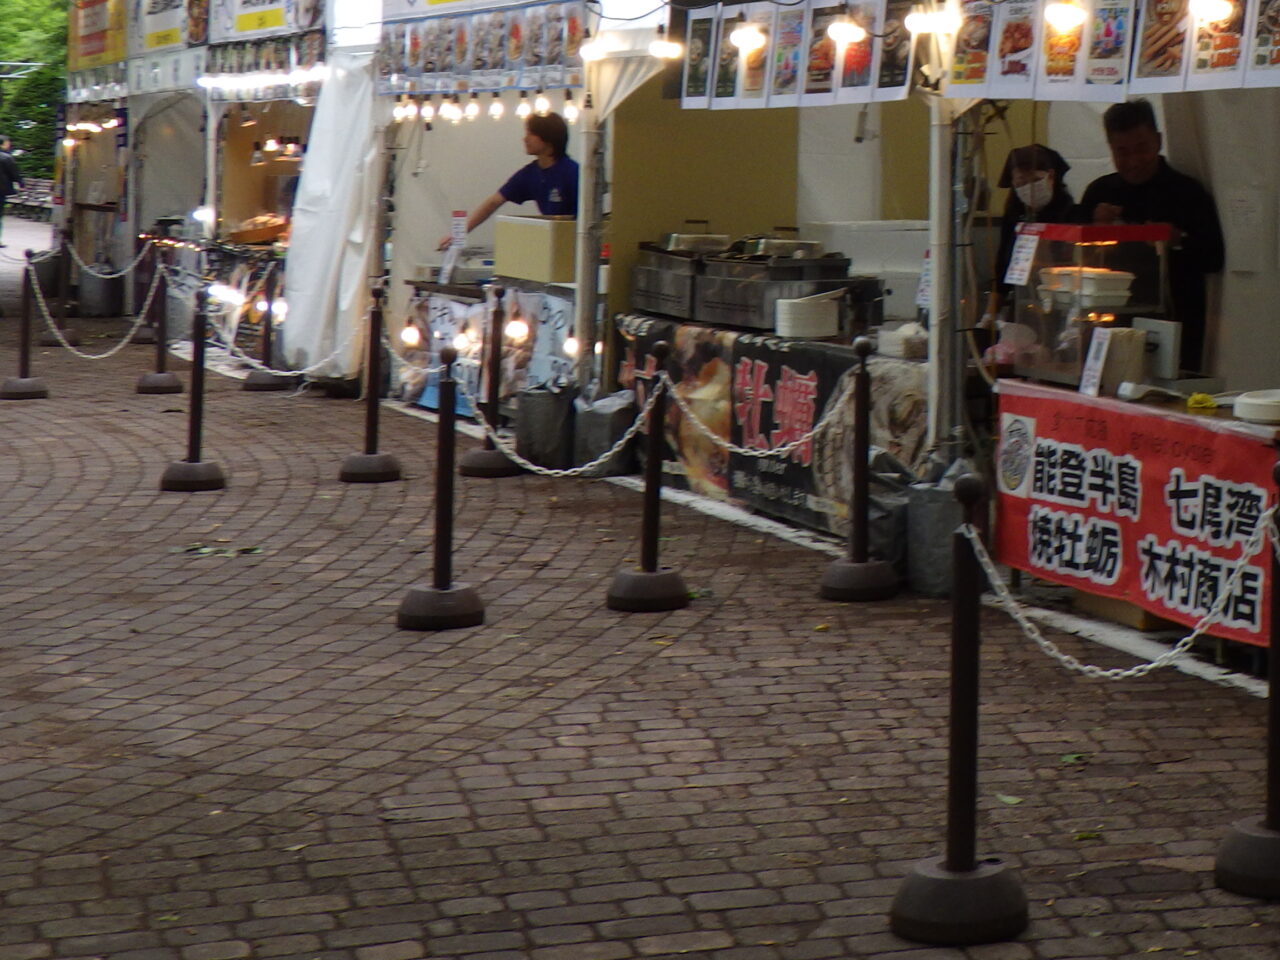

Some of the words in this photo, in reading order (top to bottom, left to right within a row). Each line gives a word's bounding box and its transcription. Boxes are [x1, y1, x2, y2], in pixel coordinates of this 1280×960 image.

[1034, 439, 1140, 519] 能登半島
[1169, 475, 1263, 547] 七尾湾
[1142, 541, 1260, 625] 木村商店
